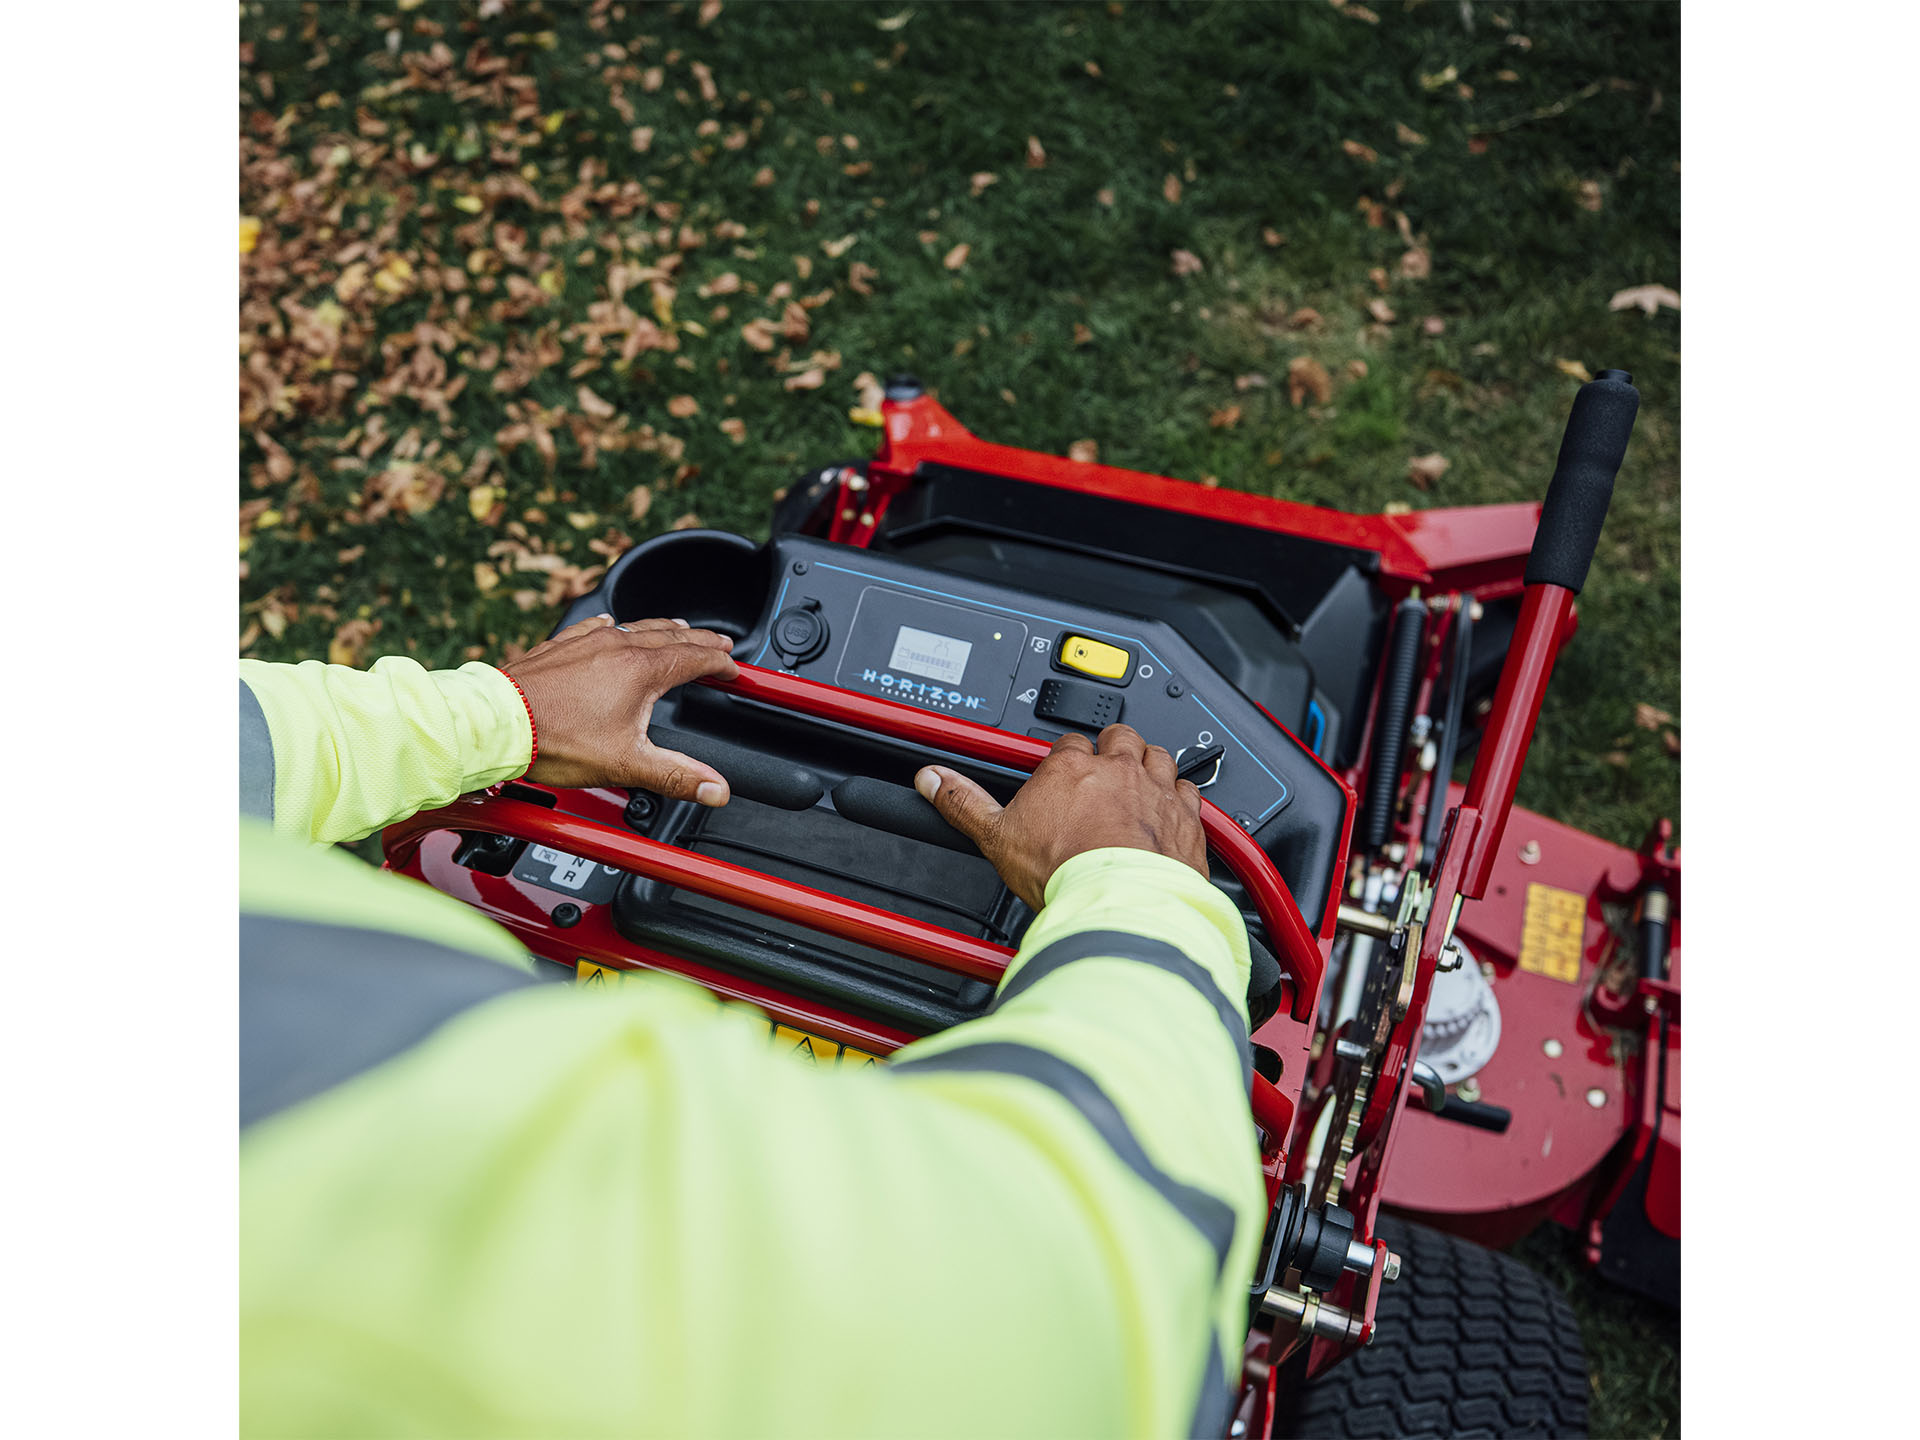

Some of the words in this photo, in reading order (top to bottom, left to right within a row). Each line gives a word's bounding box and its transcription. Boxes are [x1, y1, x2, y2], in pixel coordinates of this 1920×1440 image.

[786, 626, 810, 639] USB
[863, 668, 980, 710] HORIZON
[881, 687, 953, 710] TECHNOLOGY
[572, 856, 586, 868] N
[563, 870, 576, 882] R
